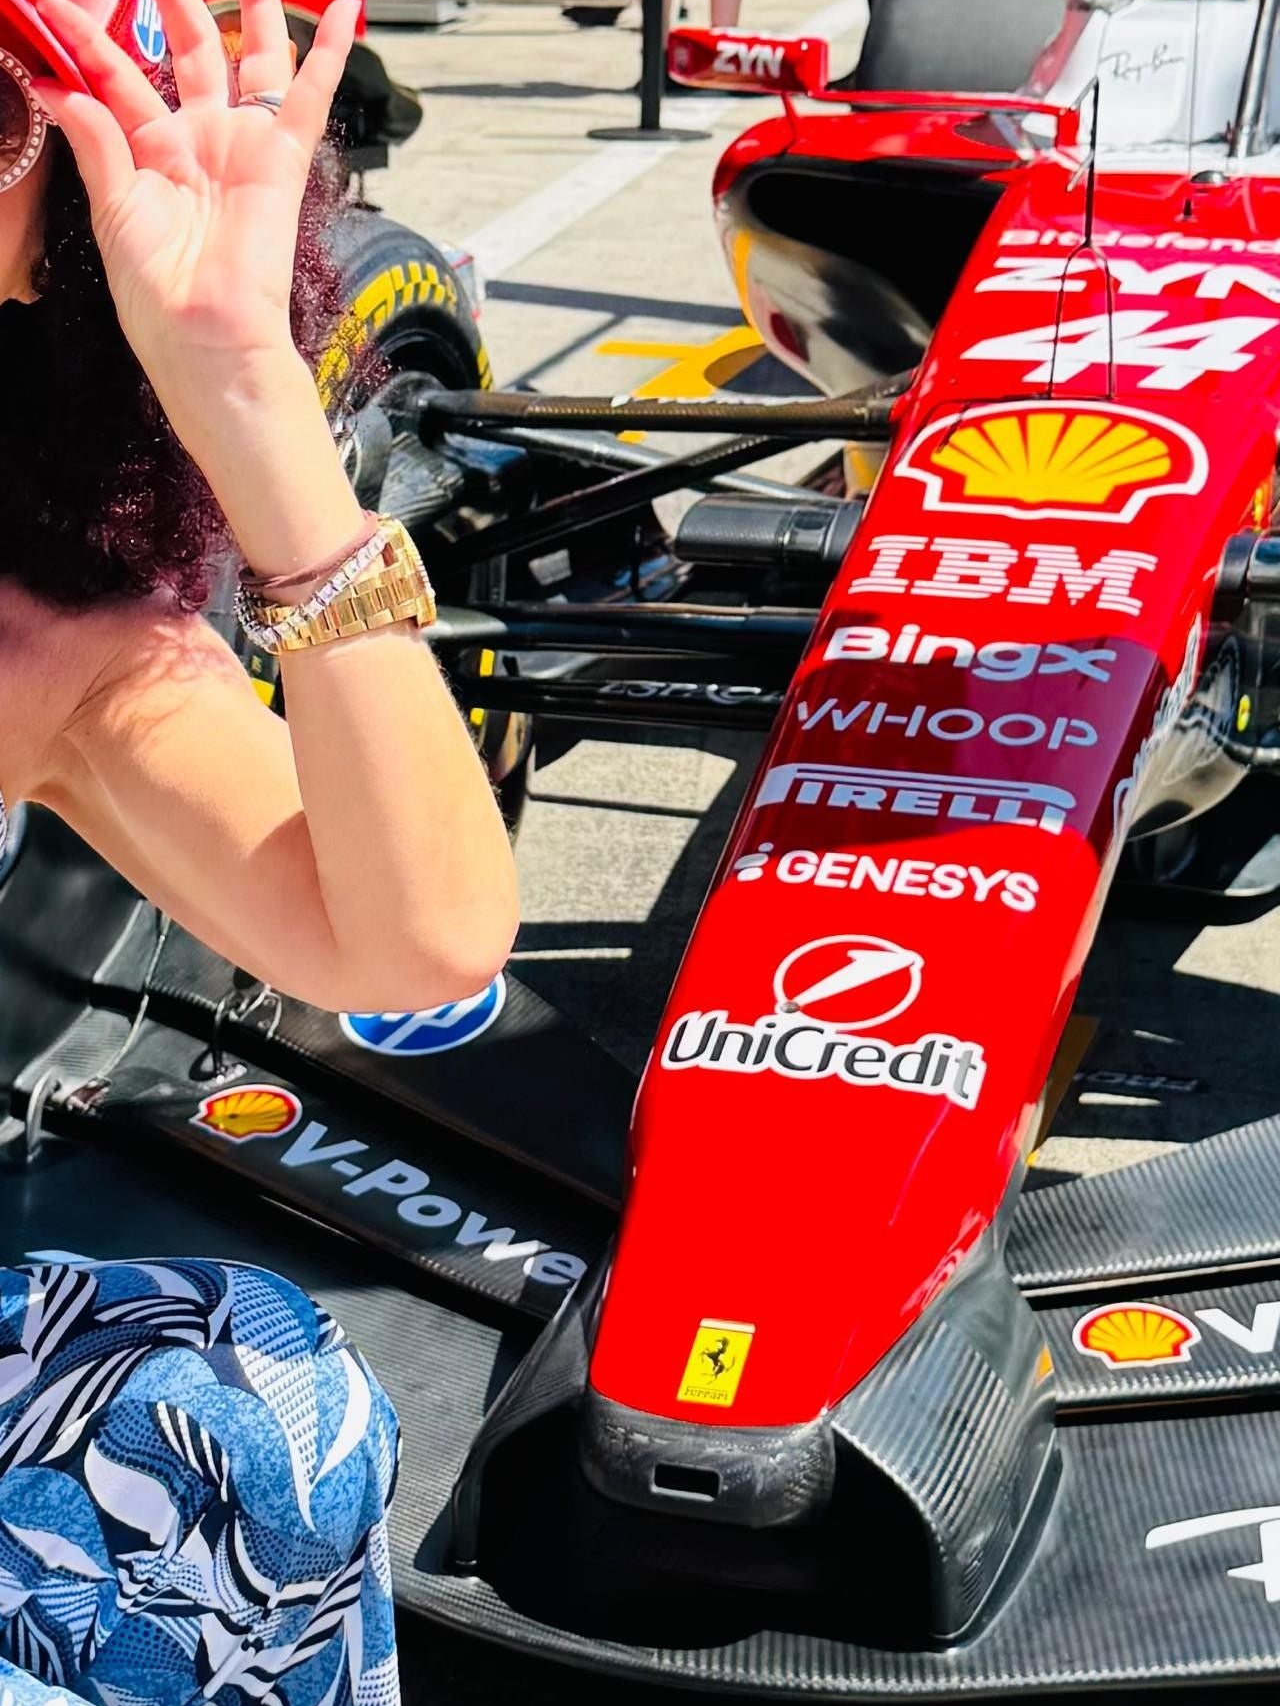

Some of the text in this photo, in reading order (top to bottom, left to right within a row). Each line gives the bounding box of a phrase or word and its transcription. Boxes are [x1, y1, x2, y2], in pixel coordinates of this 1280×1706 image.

[712, 39, 785, 79] ZYN
[1099, 43, 1188, 84] Ray-Ban
[961, 308, 1280, 391] 44
[847, 533, 1158, 617] IBM
[797, 698, 1098, 750] WHOOP
[754, 761, 1077, 835] PIRELLI
[776, 849, 1040, 912] GENESYS
[666, 1014, 983, 1103] UniCredit
[277, 1120, 588, 1287] V-Powe
[684, 1385, 729, 1401] Ferrari
